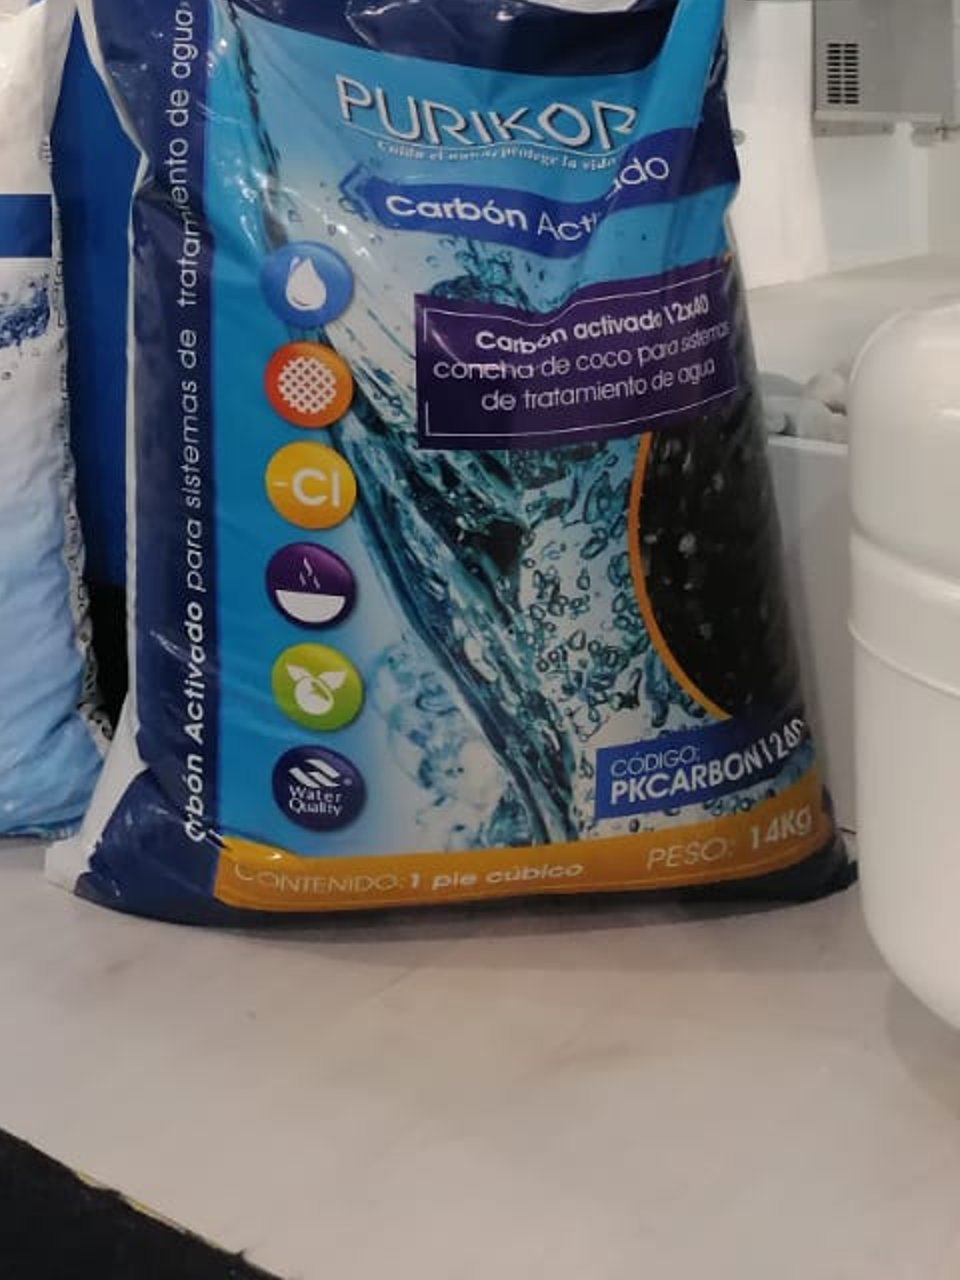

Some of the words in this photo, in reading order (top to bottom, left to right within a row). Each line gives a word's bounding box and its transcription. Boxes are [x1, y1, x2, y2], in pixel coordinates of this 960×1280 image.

[171, 8, 199, 79] agua
[165, 88, 190, 128] de
[385, 194, 528, 230] Carbón
[176, 328, 198, 370] de
[475, 326, 568, 355] Carbón
[572, 311, 663, 341] activado
[433, 358, 535, 381] concha
[541, 356, 571, 378] de
[575, 348, 633, 372] coco
[637, 338, 679, 368] para
[481, 388, 517, 411] de
[524, 376, 648, 410] tratamiento
[651, 366, 674, 391] de
[678, 357, 716, 386] agua
[179, 380, 202, 510] sistemas
[185, 518, 207, 593] para
[183, 600, 206, 744] Activado
[288, 784, 344, 804] Water
[288, 797, 344, 817] Quality
[646, 835, 736, 871] PESO:
[410, 872, 421, 890] 1
[431, 871, 478, 893] pie
[485, 861, 585, 884] cúbico
